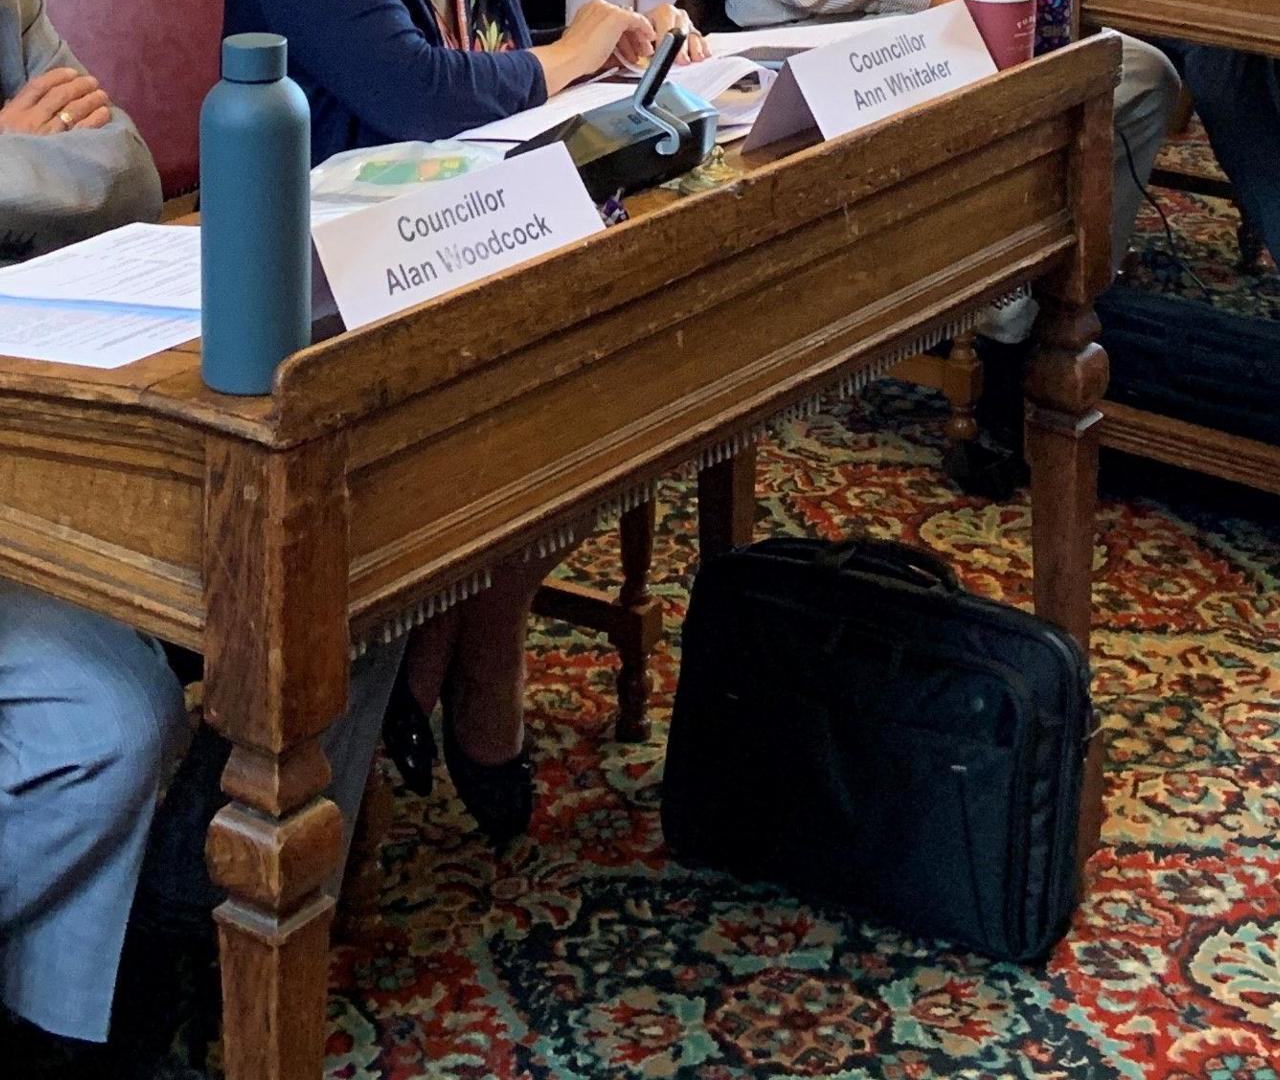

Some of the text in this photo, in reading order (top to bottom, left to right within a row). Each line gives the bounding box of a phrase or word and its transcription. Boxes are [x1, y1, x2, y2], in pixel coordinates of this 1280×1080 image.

[849, 32, 927, 73] Councillor
[854, 59, 953, 111] Ann Whitaker
[397, 187, 507, 243] Councillor
[385, 214, 554, 296] Alan Woodcock
